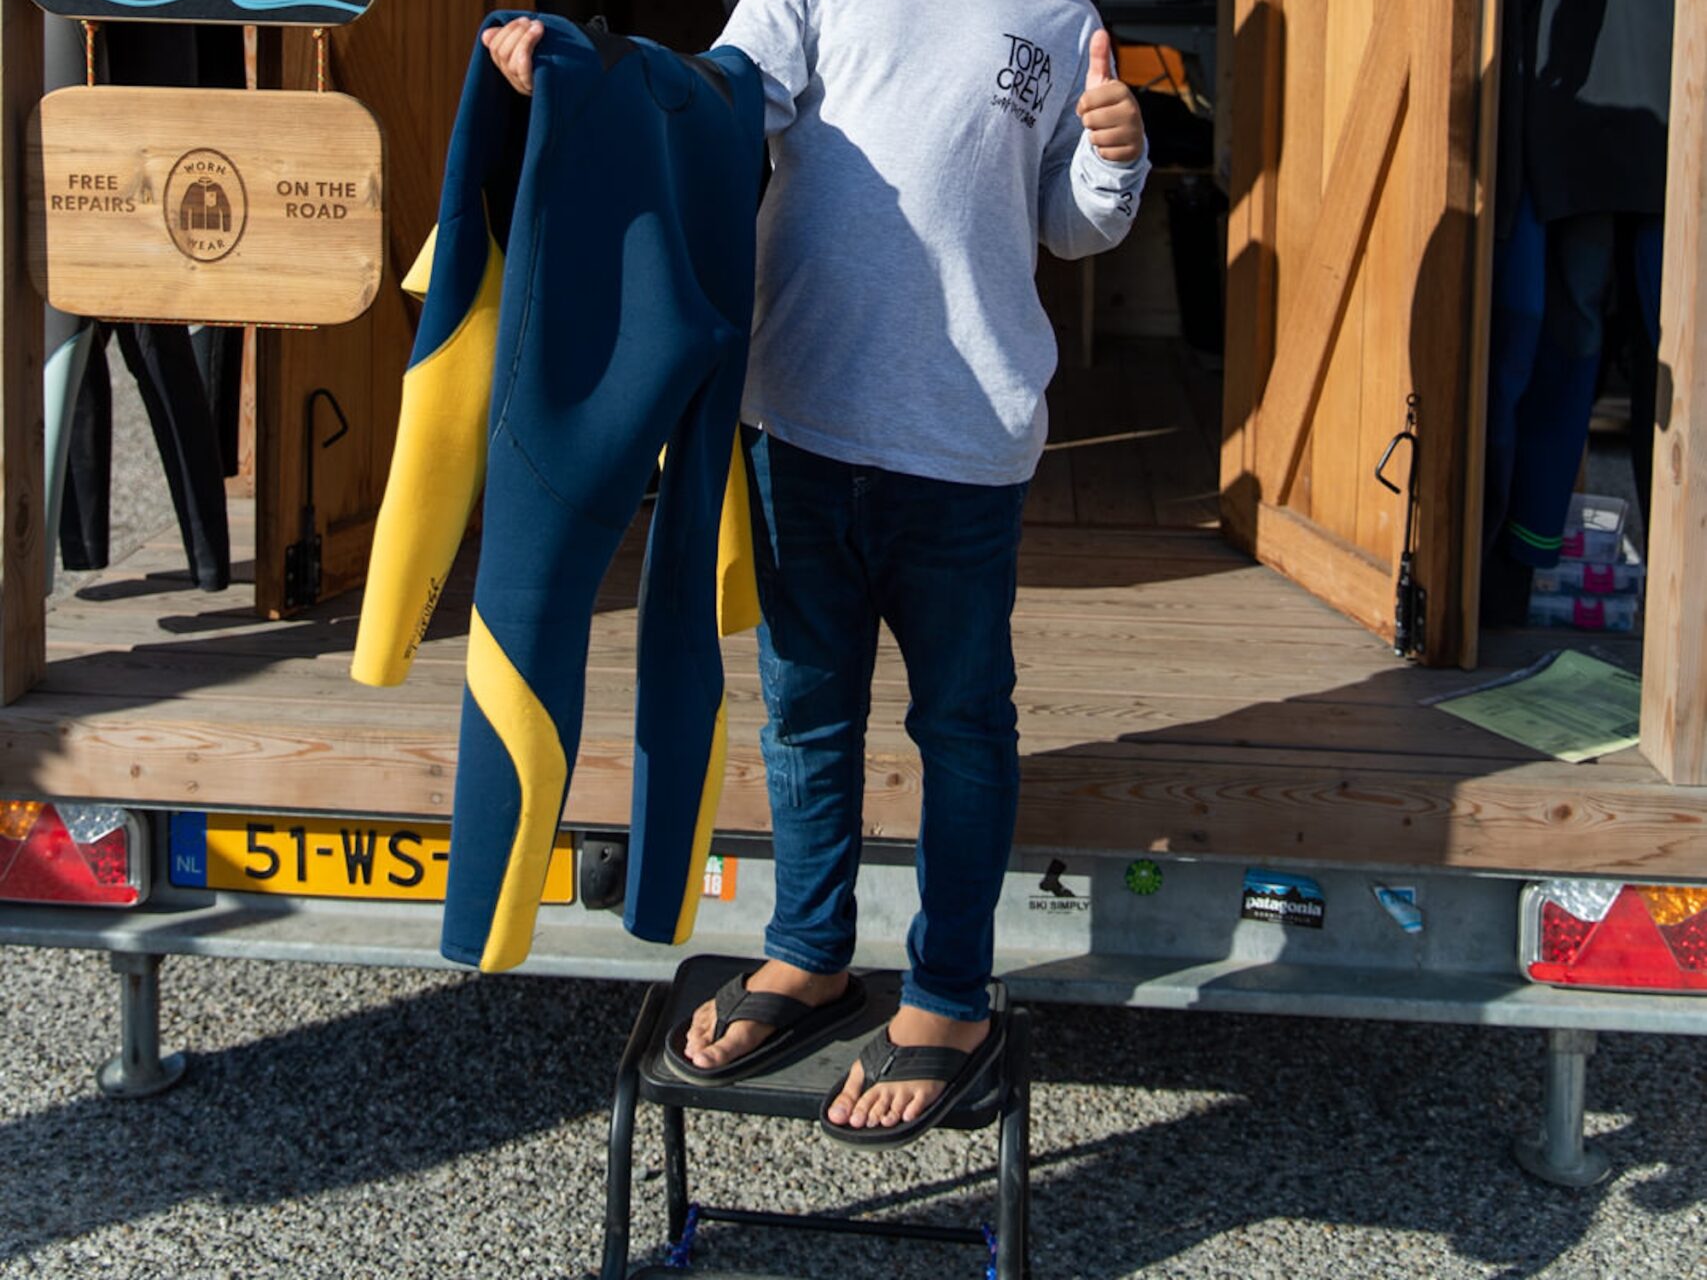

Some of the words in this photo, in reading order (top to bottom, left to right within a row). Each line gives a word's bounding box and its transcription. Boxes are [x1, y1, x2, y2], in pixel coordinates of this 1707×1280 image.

[1003, 33, 1053, 84] TOPA
[997, 67, 1053, 113] CREW
[184, 161, 227, 176] WORN
[68, 174, 118, 191] FREE
[276, 180, 309, 198] ON
[316, 182, 357, 199] THE
[52, 195, 137, 213] REPAIRS
[286, 203, 347, 220] ROAD
[185, 237, 227, 252] WEAR
[244, 822, 449, 887] 51-WS-
[175, 854, 201, 874] NL
[1029, 900, 1047, 911] SKI
[1050, 899, 1089, 911] SIMPLY
[1245, 895, 1322, 918] patagonia
